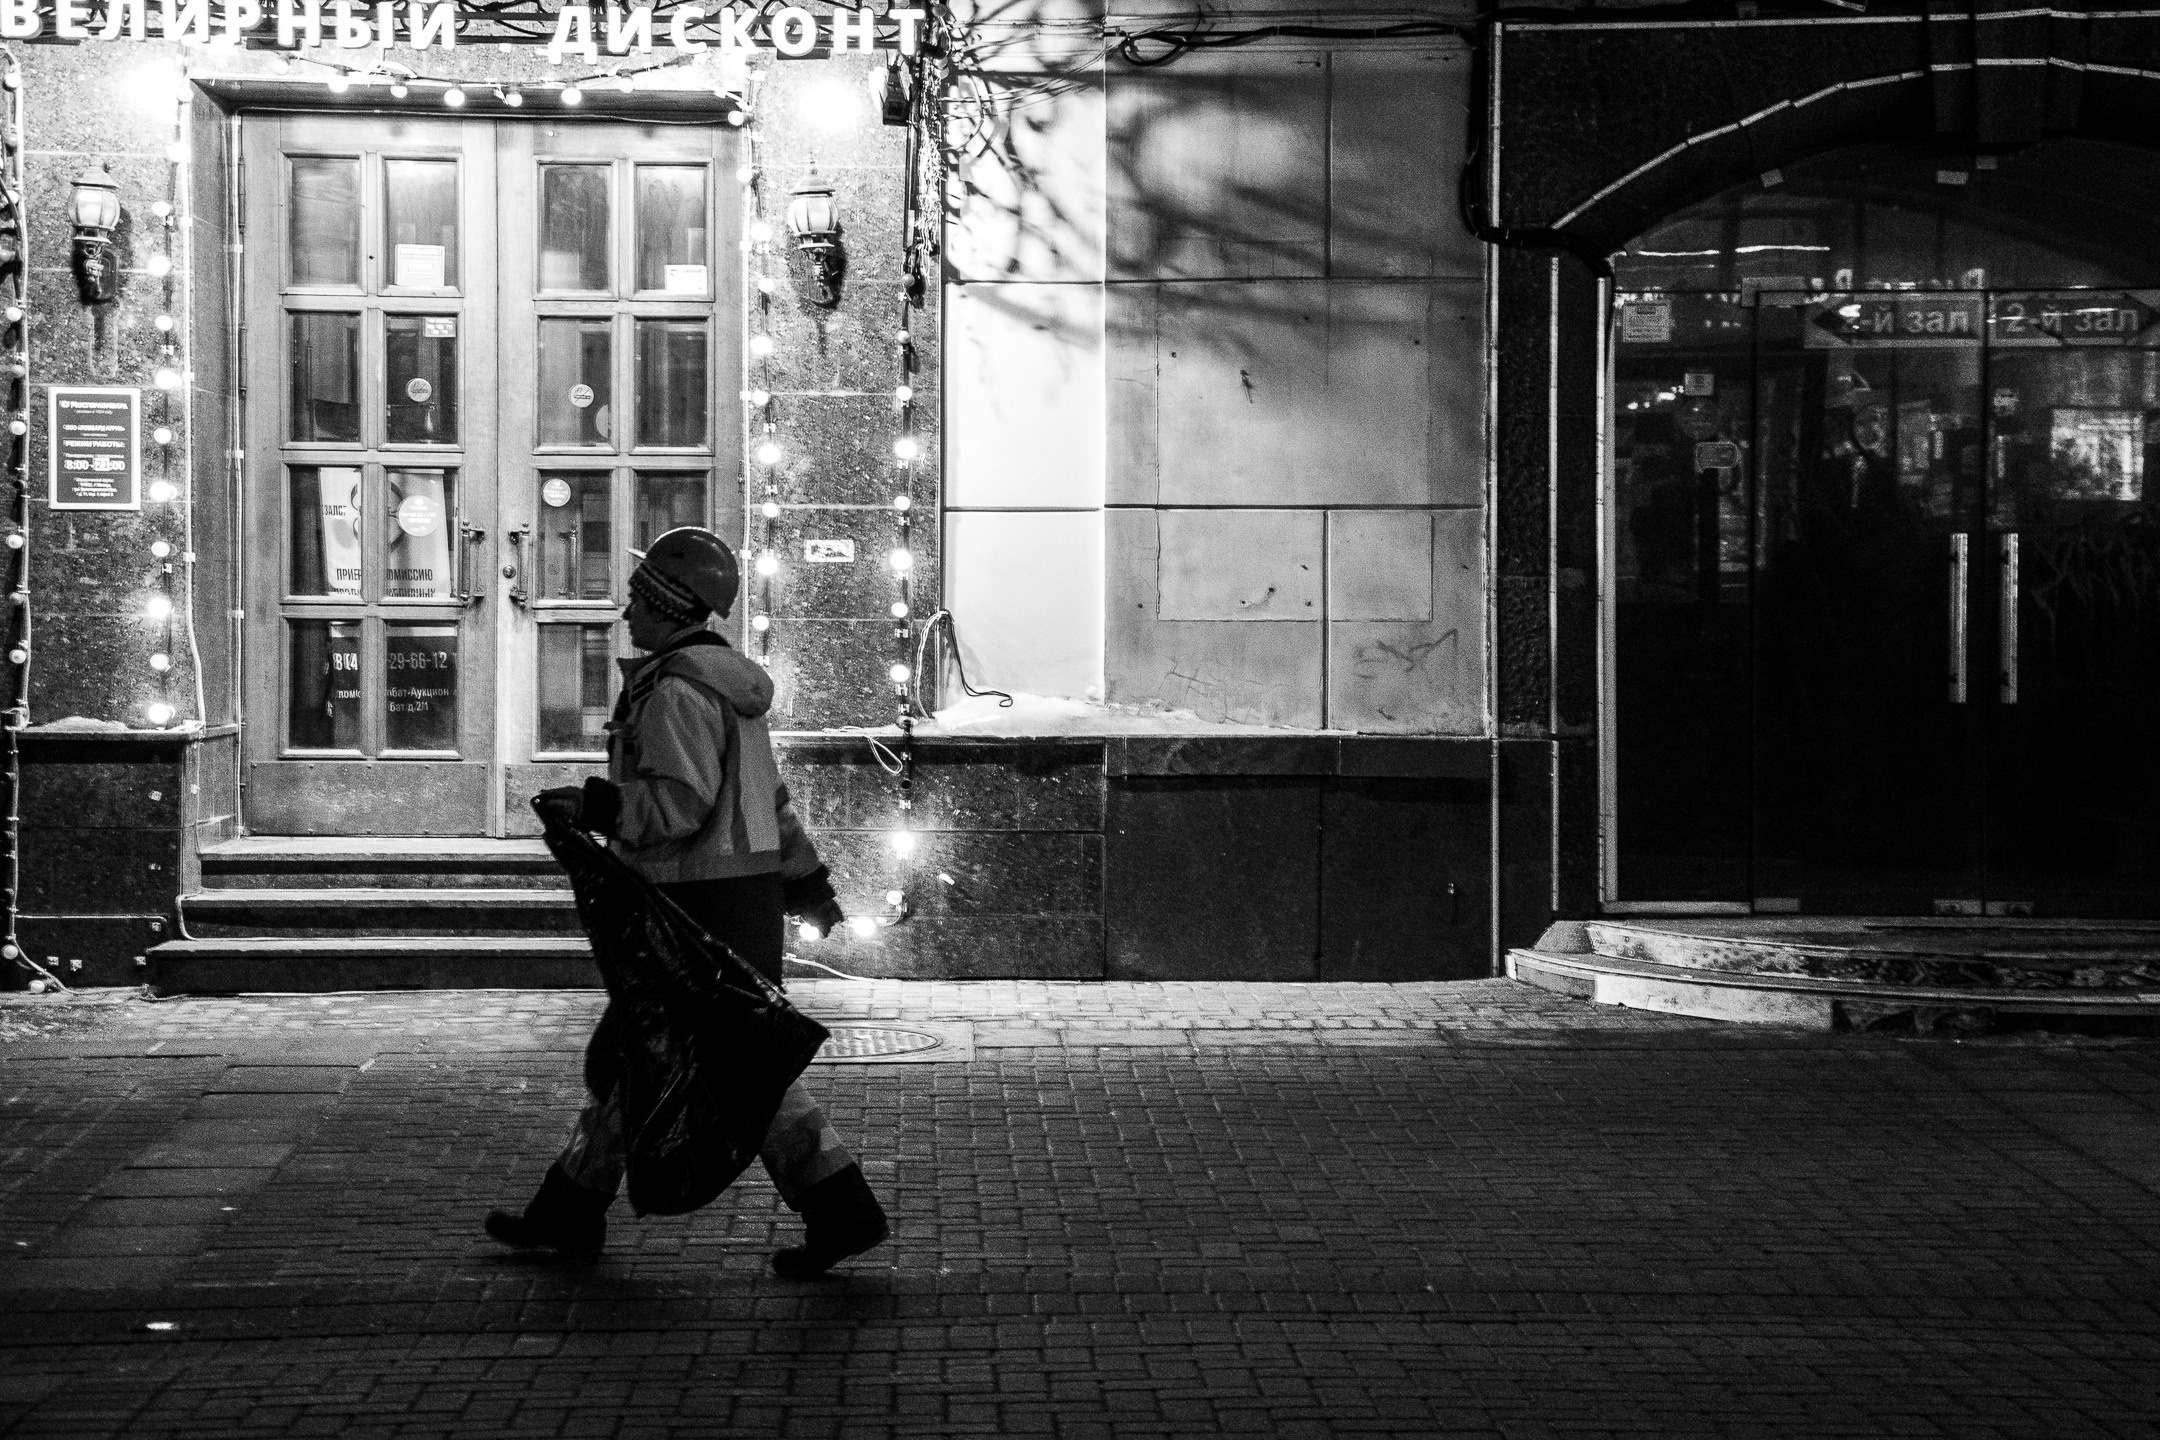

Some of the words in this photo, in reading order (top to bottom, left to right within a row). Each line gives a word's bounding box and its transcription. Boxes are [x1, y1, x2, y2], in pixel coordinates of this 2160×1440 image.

[548, 4, 925, 64] ДИСКОНТ
[1907, 309, 1970, 333] зал
[2074, 308, 2139, 333] зал
[386, 568, 433, 581] ОМИССИЮ
